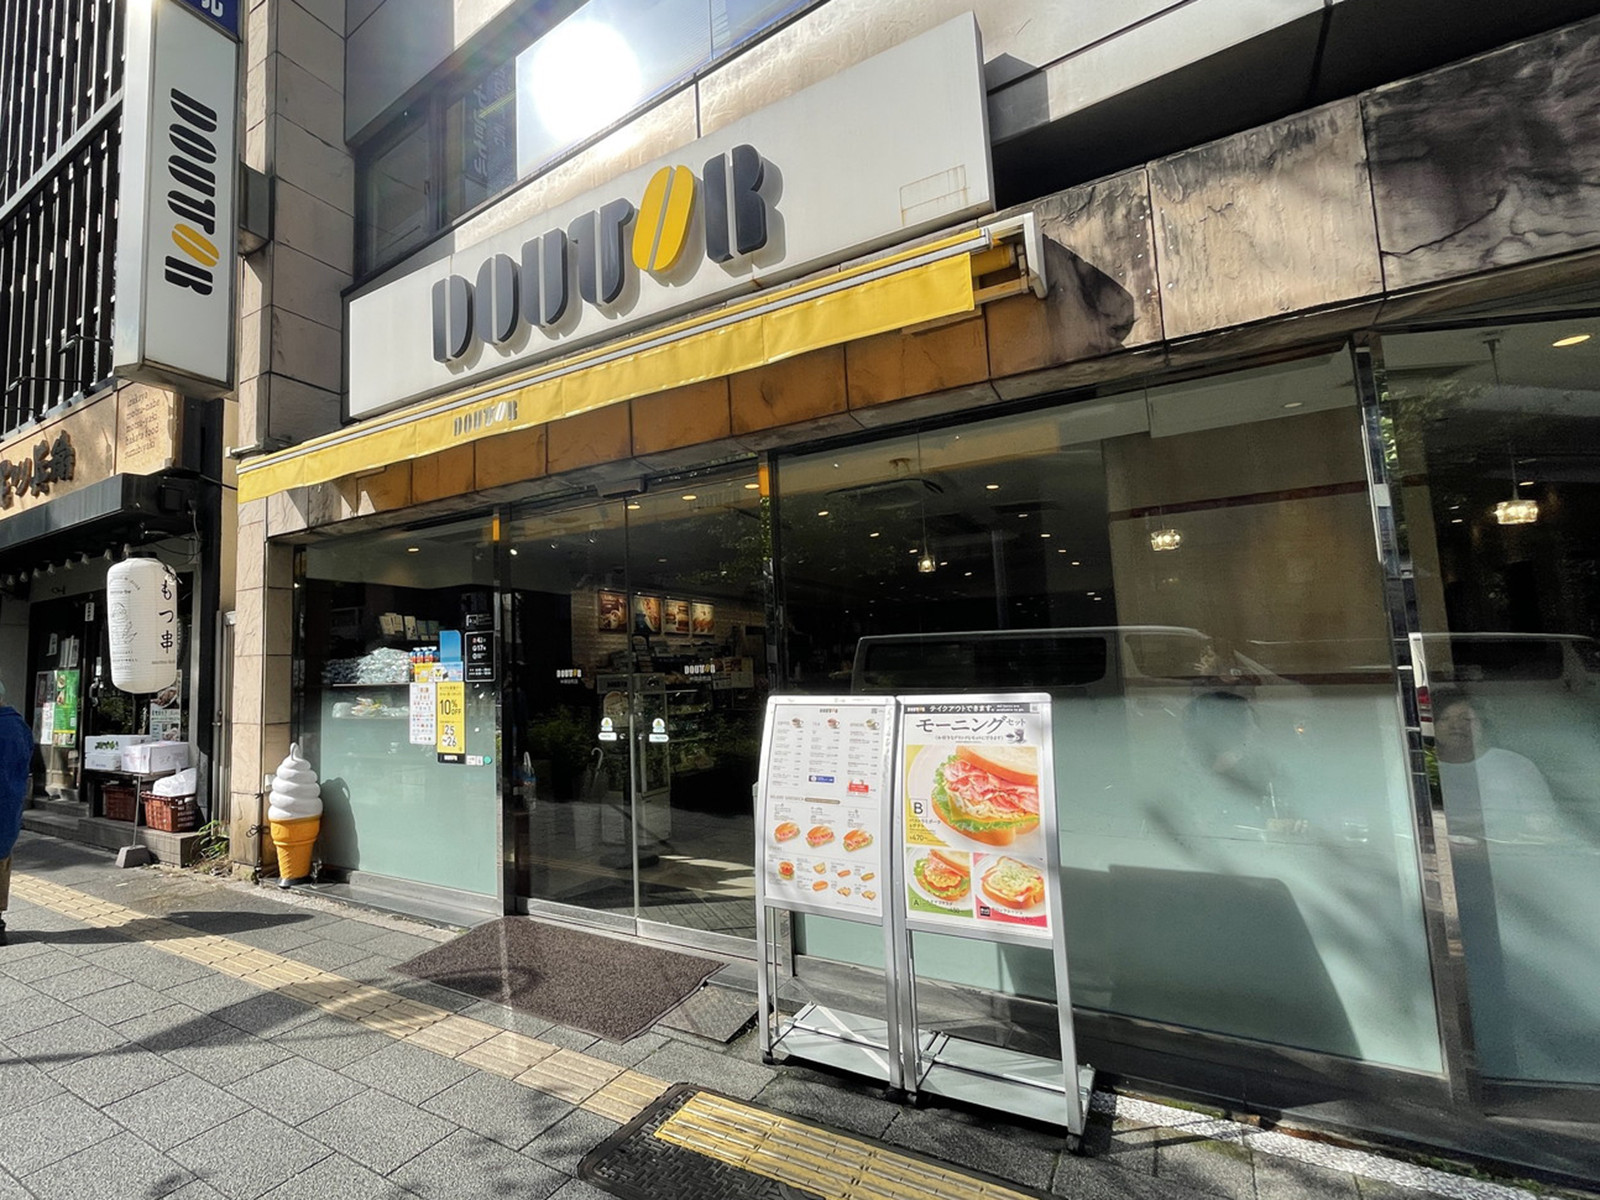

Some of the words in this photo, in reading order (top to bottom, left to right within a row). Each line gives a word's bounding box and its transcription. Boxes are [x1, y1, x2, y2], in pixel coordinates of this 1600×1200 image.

[164, 87, 220, 296] DOUTOR
[431, 144, 768, 364] DOUTOR
[454, 400, 518, 436] DOUTOR
[159, 579, 175, 654] もつ串
[915, 715, 1007, 734] モーニング
[929, 704, 995, 712] テイクアウトできます。
[913, 801, 924, 814] B
